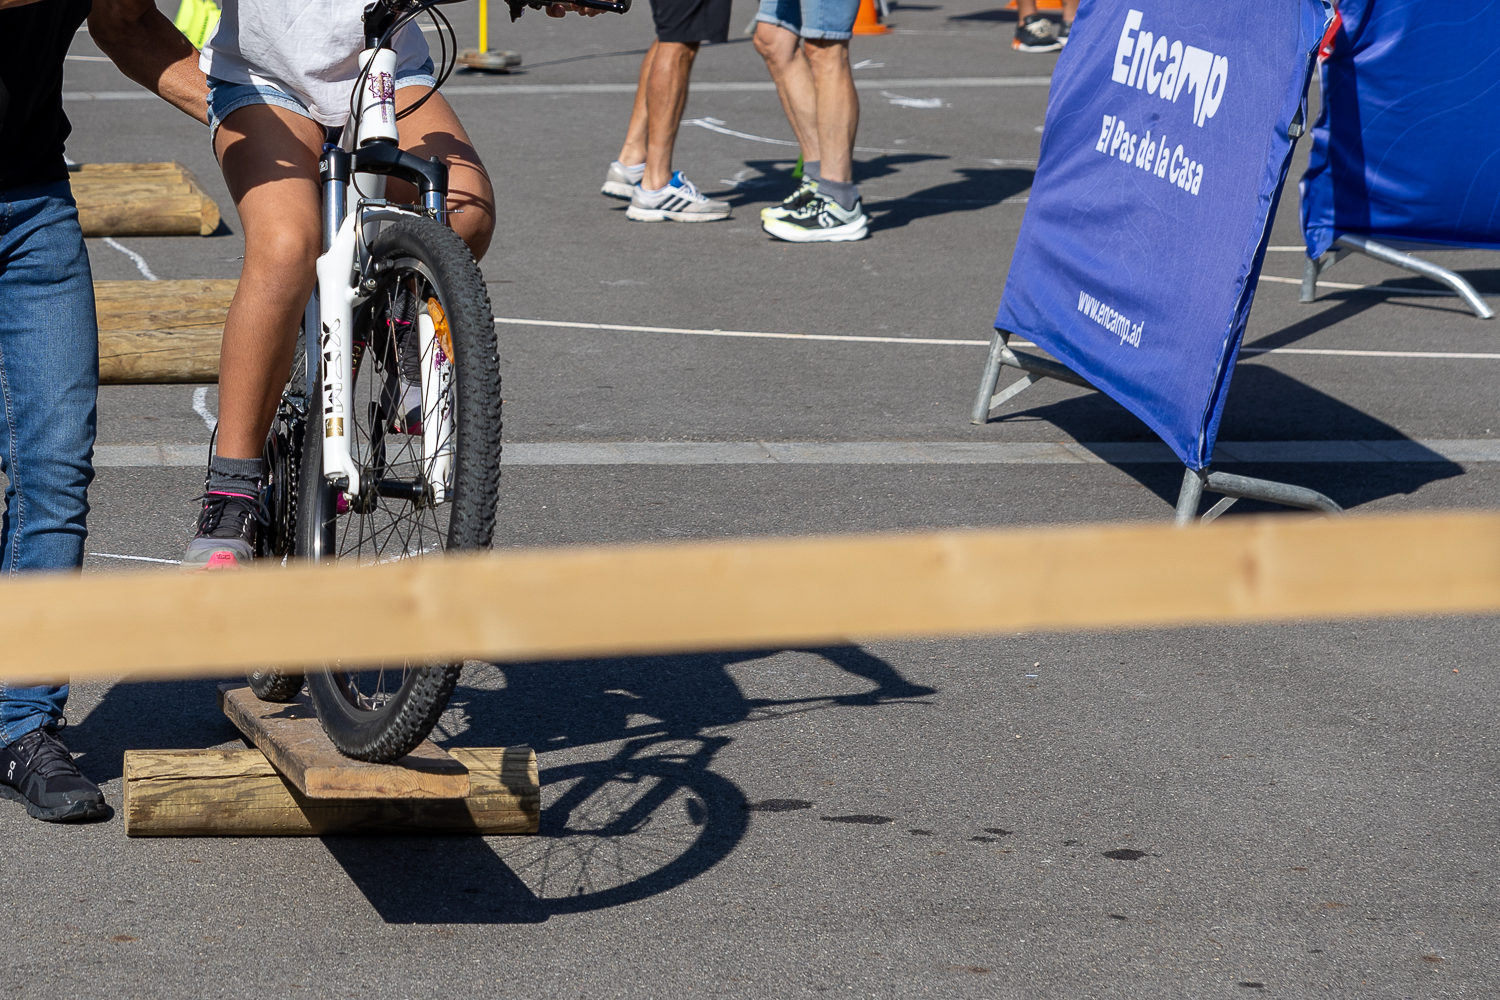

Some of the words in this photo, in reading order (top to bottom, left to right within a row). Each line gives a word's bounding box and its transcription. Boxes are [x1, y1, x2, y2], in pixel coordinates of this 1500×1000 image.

[1111, 8, 1229, 128] Encamp
[1095, 114, 1117, 154] El
[1110, 120, 1137, 164] Pas
[1135, 130, 1156, 172] de
[1153, 134, 1170, 179] la
[1169, 143, 1204, 196] Casa
[1077, 290, 1145, 349] www.encamp.ad
